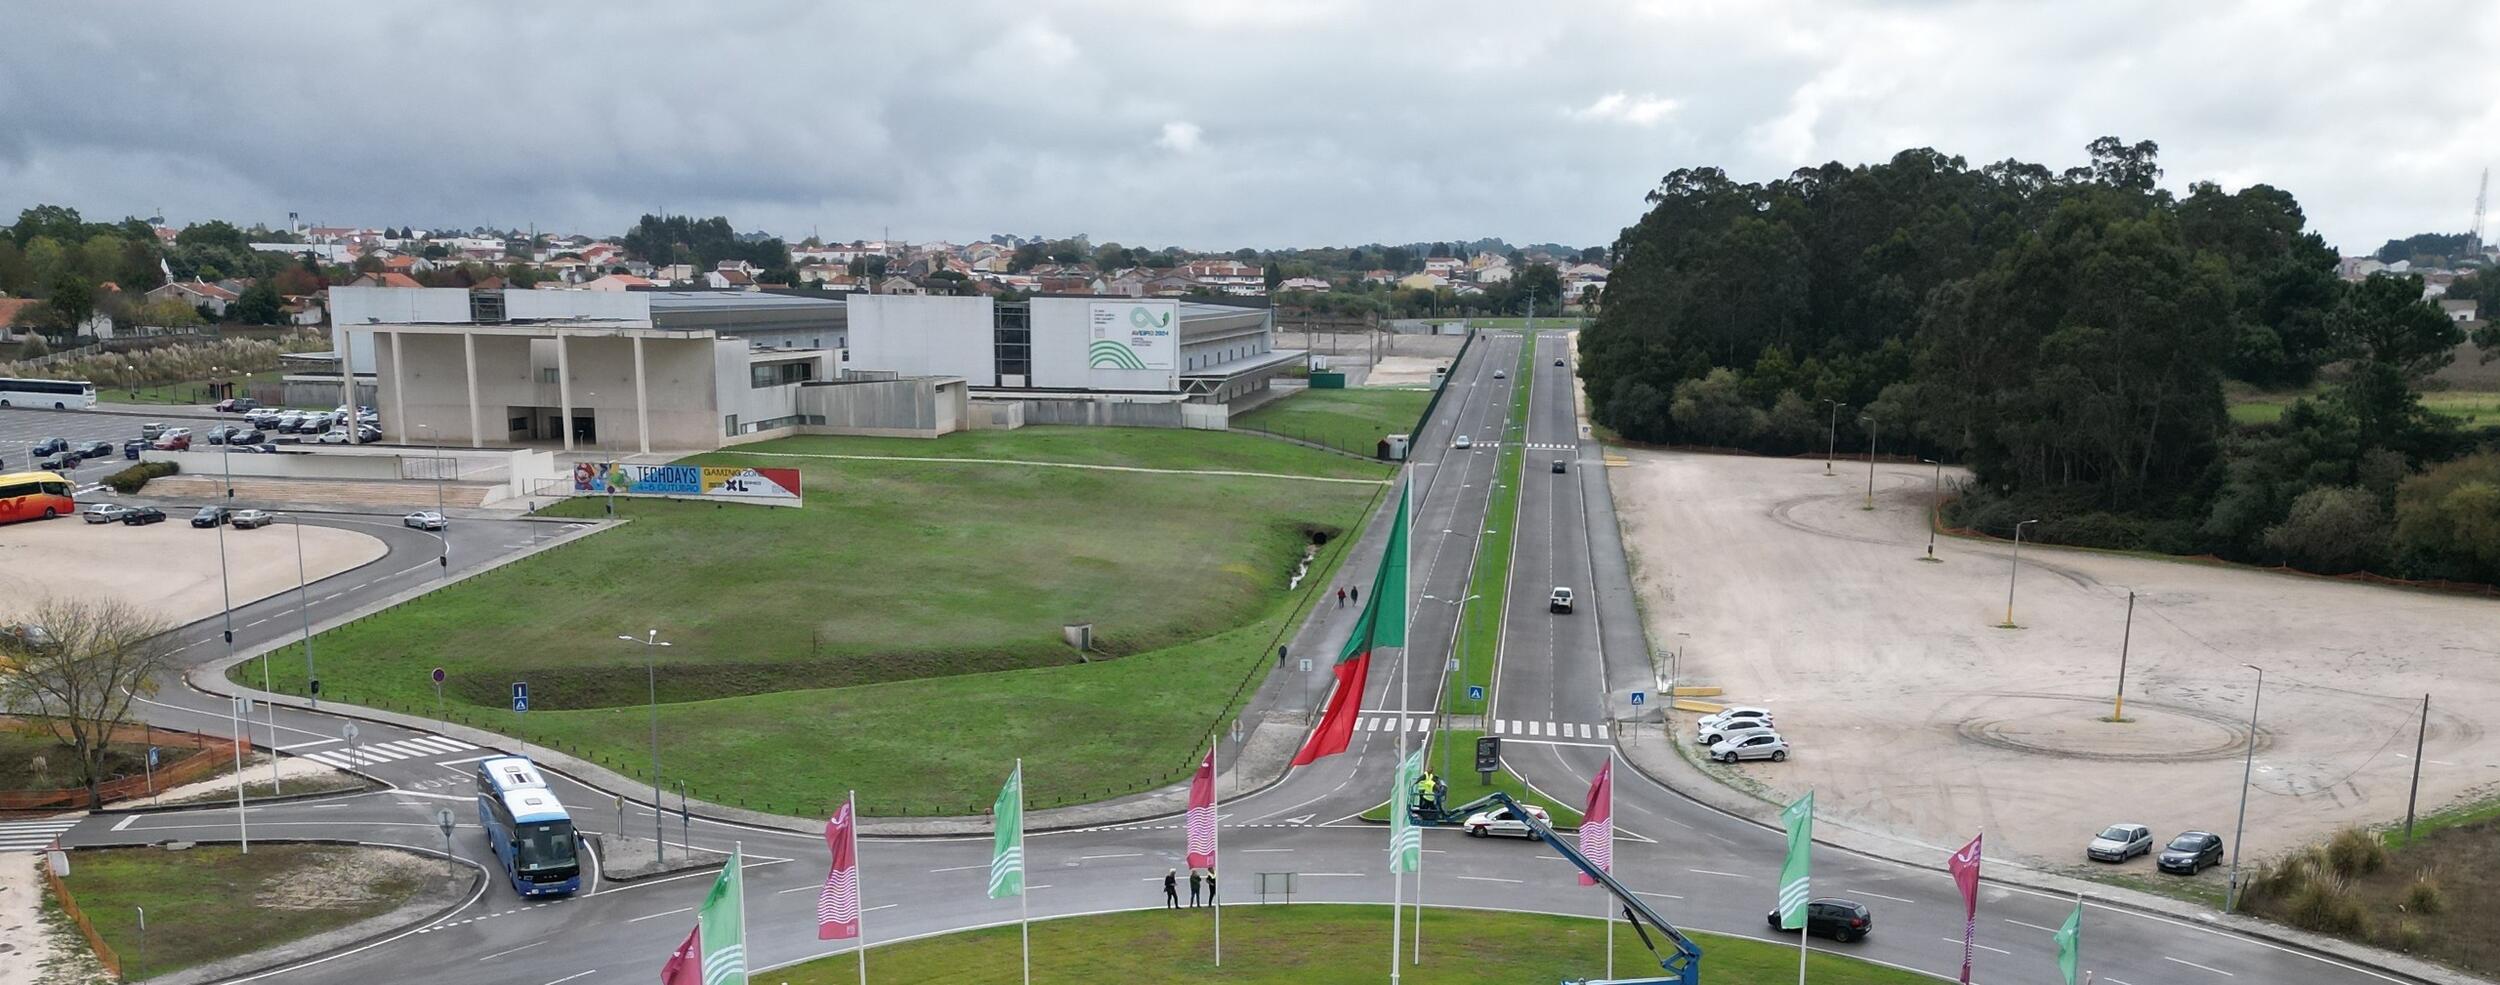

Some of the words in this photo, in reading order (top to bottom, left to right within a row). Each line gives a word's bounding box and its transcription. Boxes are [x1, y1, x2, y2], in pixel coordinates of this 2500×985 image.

[636, 466, 697, 484] TECHDAYS
[703, 468, 741, 477] GAMING
[725, 479, 748, 492] XL
[414, 775, 471, 790] STOP
